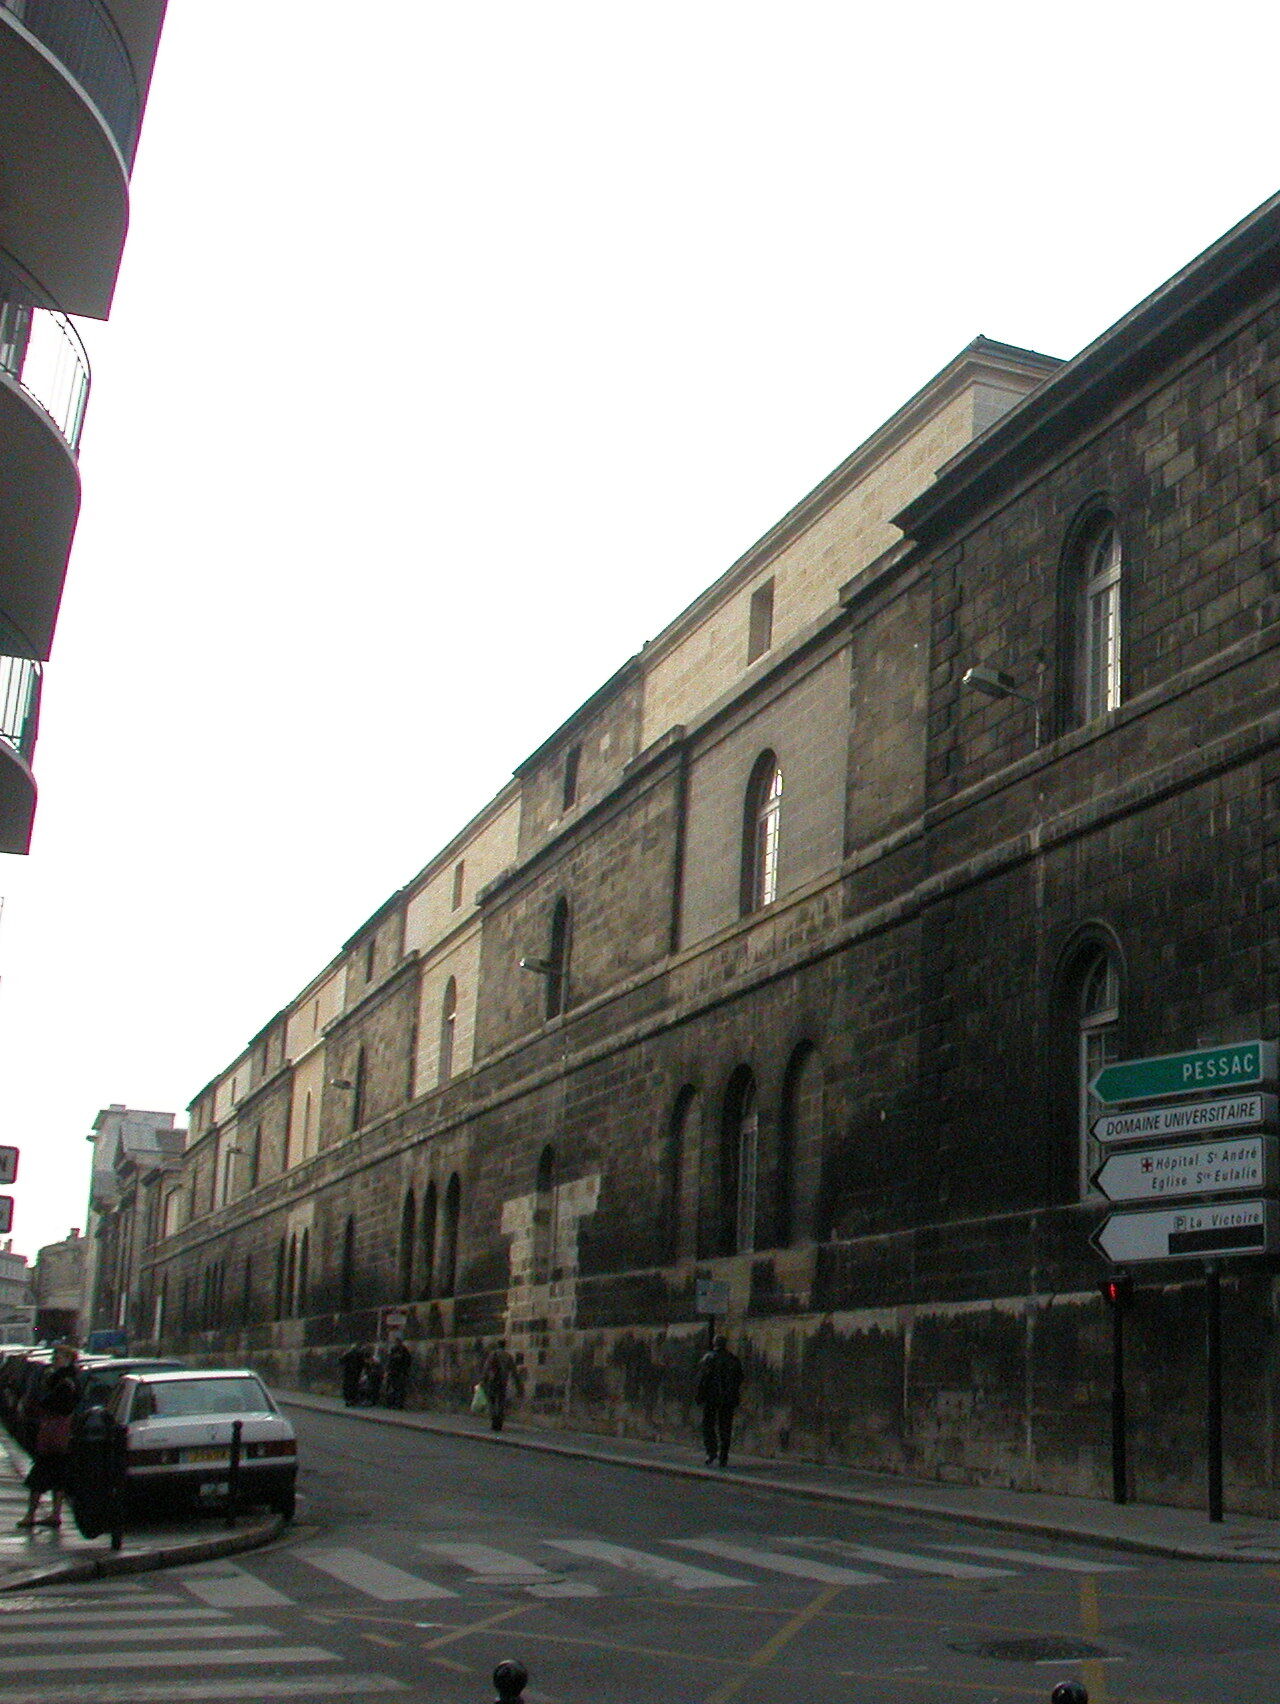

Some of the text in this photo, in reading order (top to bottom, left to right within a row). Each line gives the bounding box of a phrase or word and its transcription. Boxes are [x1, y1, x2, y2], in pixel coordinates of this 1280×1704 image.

[1182, 1053, 1254, 1082] PESSAC
[1106, 1101, 1255, 1136] DOMAINE UNIVERSITAIRE
[1156, 1153, 1199, 1170] Hôpital
[1222, 1146, 1257, 1161] André
[1152, 1174, 1188, 1191] Eglise
[1214, 1166, 1257, 1182] Eulalie
[1190, 1216, 1202, 1228] La
[1211, 1211, 1259, 1226] Victoire
